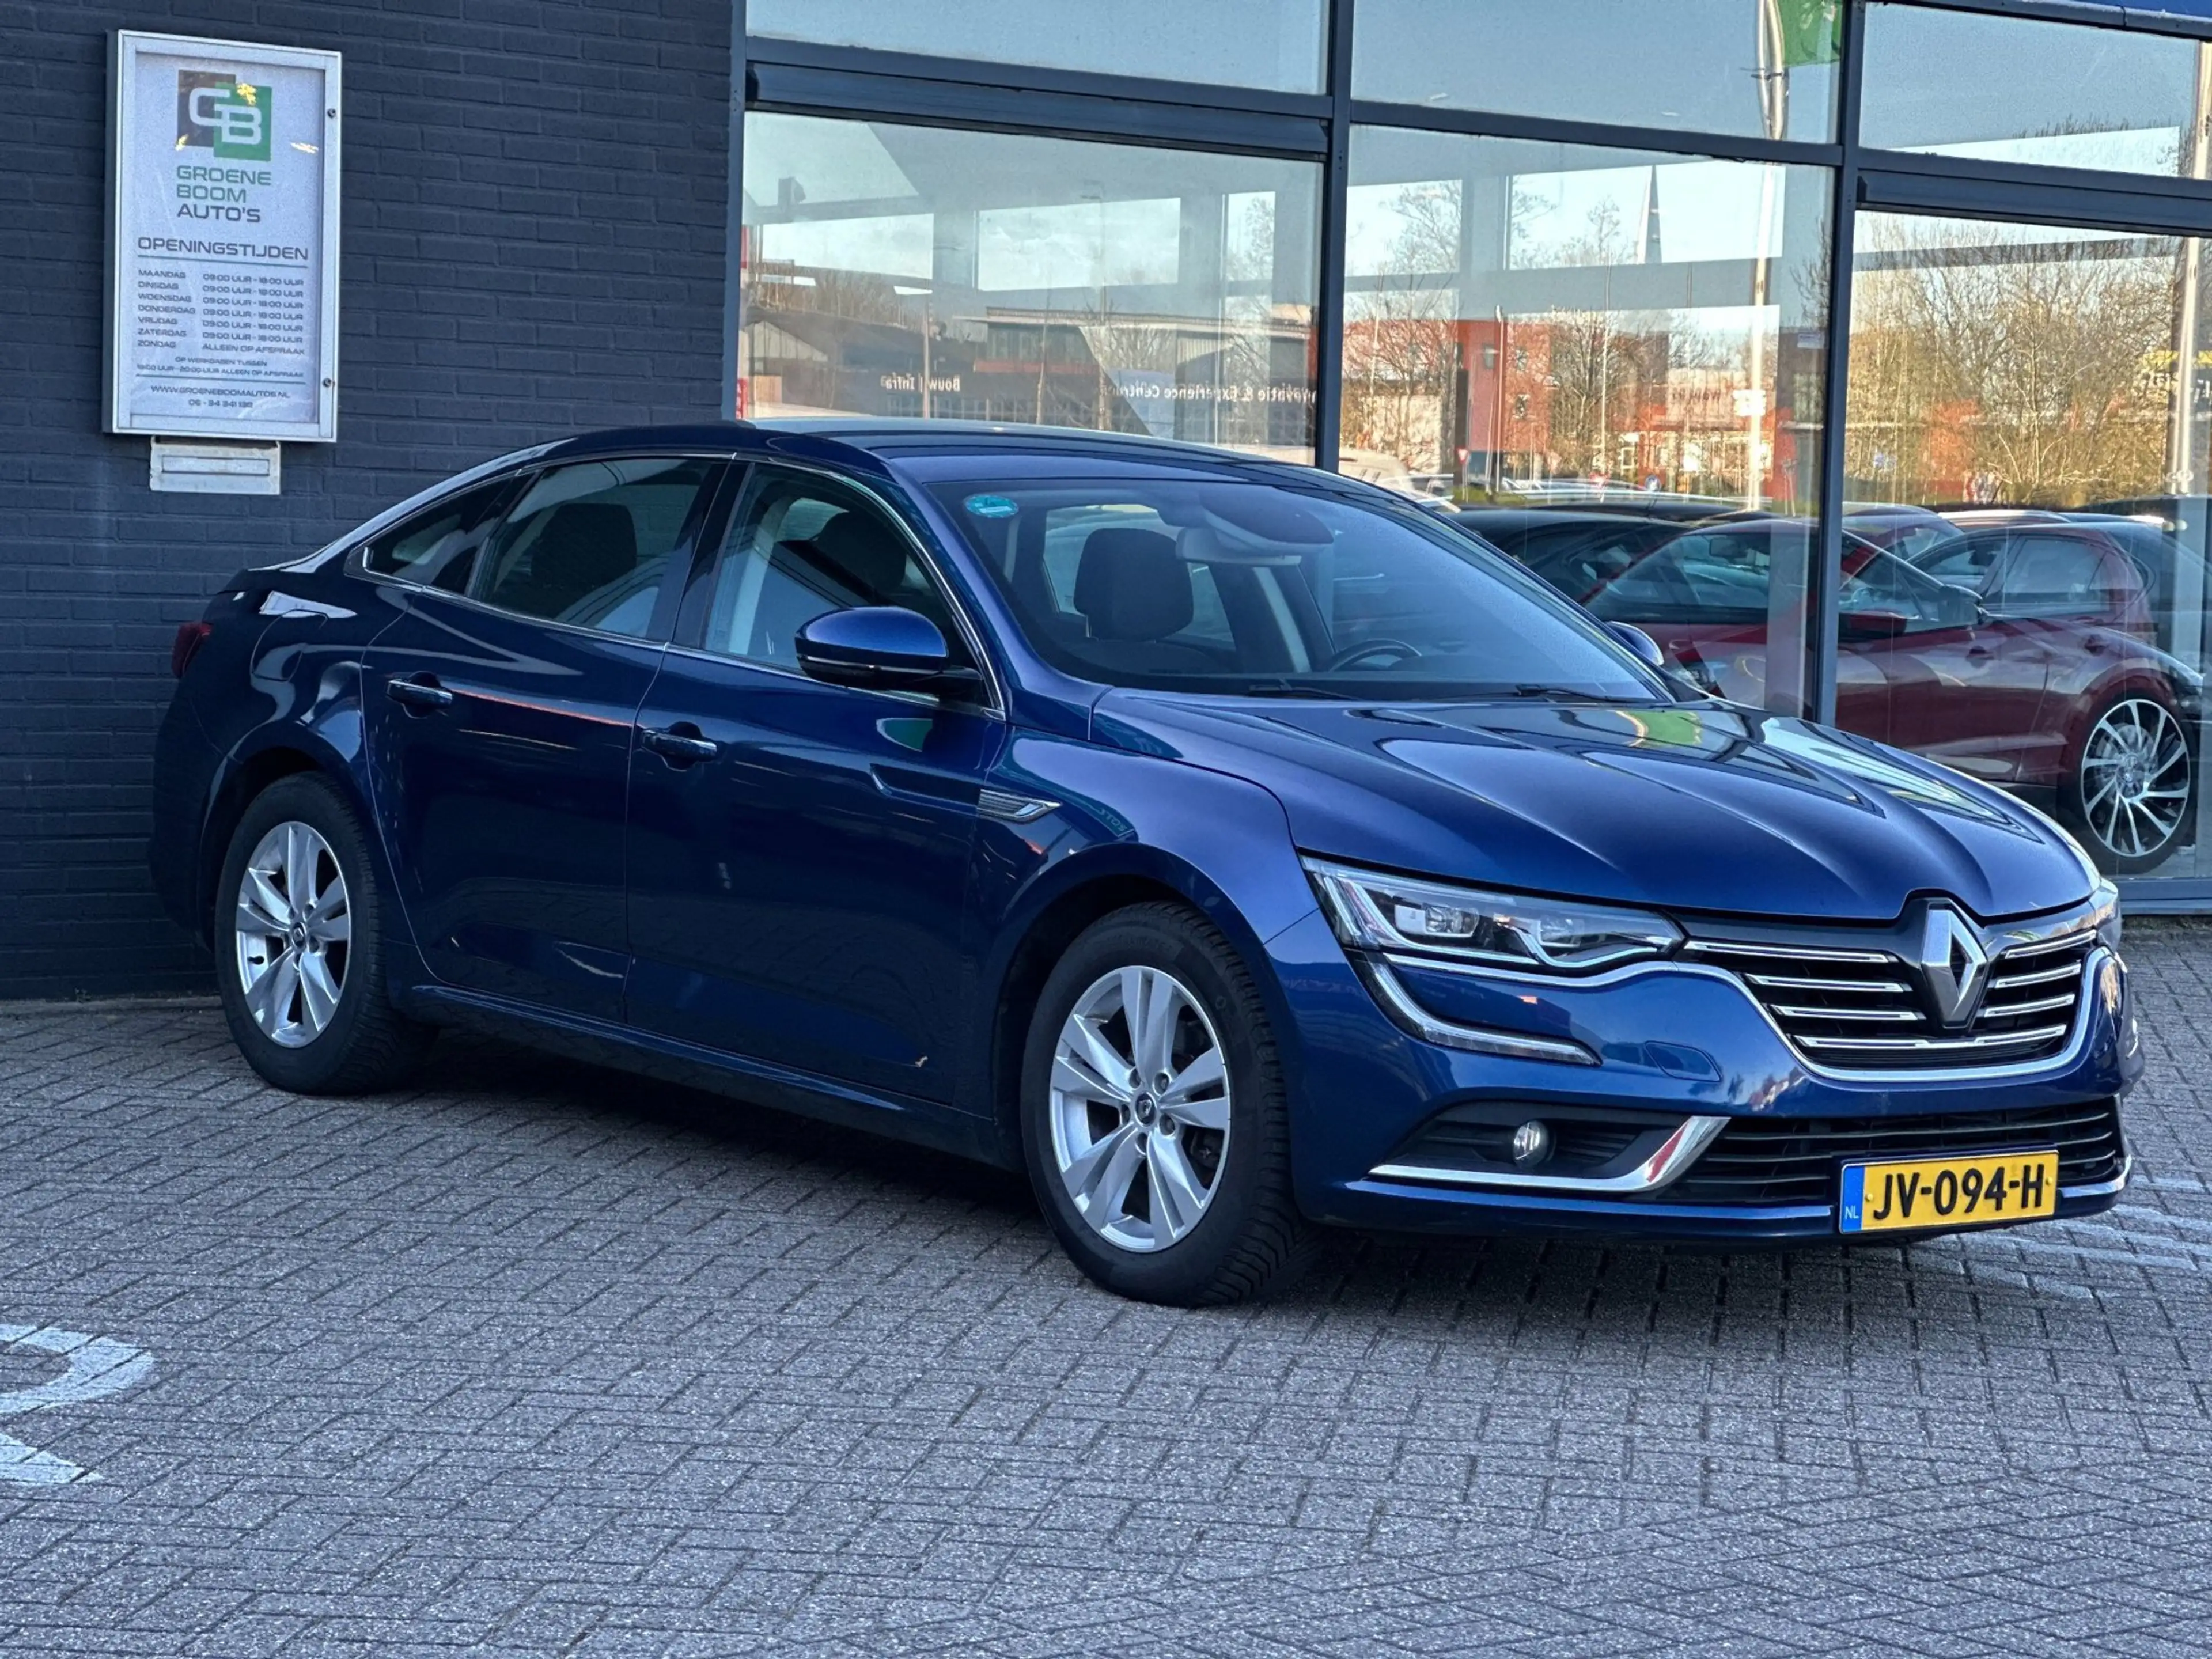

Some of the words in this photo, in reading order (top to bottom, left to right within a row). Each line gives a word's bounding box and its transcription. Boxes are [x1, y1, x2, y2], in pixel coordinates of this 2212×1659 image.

[188, 87, 262, 145] GB
[176, 165, 272, 186] GROENE
[176, 184, 247, 203] BOOM
[177, 203, 262, 223] AUTO'S
[138, 237, 308, 260] OPENINGSTIJDEN
[138, 270, 186, 278] MAANDAG
[231, 275, 252, 283] UUR
[284, 278, 304, 286] UUR
[231, 286, 252, 294] UUR
[284, 289, 304, 297] UUR
[138, 293, 192, 302] WOENSDAG
[231, 298, 252, 306] UUR
[284, 301, 304, 309] UUR
[138, 305, 196, 314] DONDERDAG
[231, 310, 252, 318] UUR
[283, 313, 304, 321] UUR
[138, 316, 177, 324] VRIJDAG
[231, 321, 252, 329] UUR
[283, 324, 303, 332] UUR
[138, 328, 187, 337] ZATERDAG
[231, 333, 252, 341] UUR
[283, 336, 303, 344] UUR
[138, 340, 176, 349] ZONDAG
[202, 343, 238, 353] ALLEEN
[255, 346, 305, 355] AFSPRAAK
[1873, 1162, 2046, 1221] JV-094-H
[1844, 1206, 1860, 1220] NL
